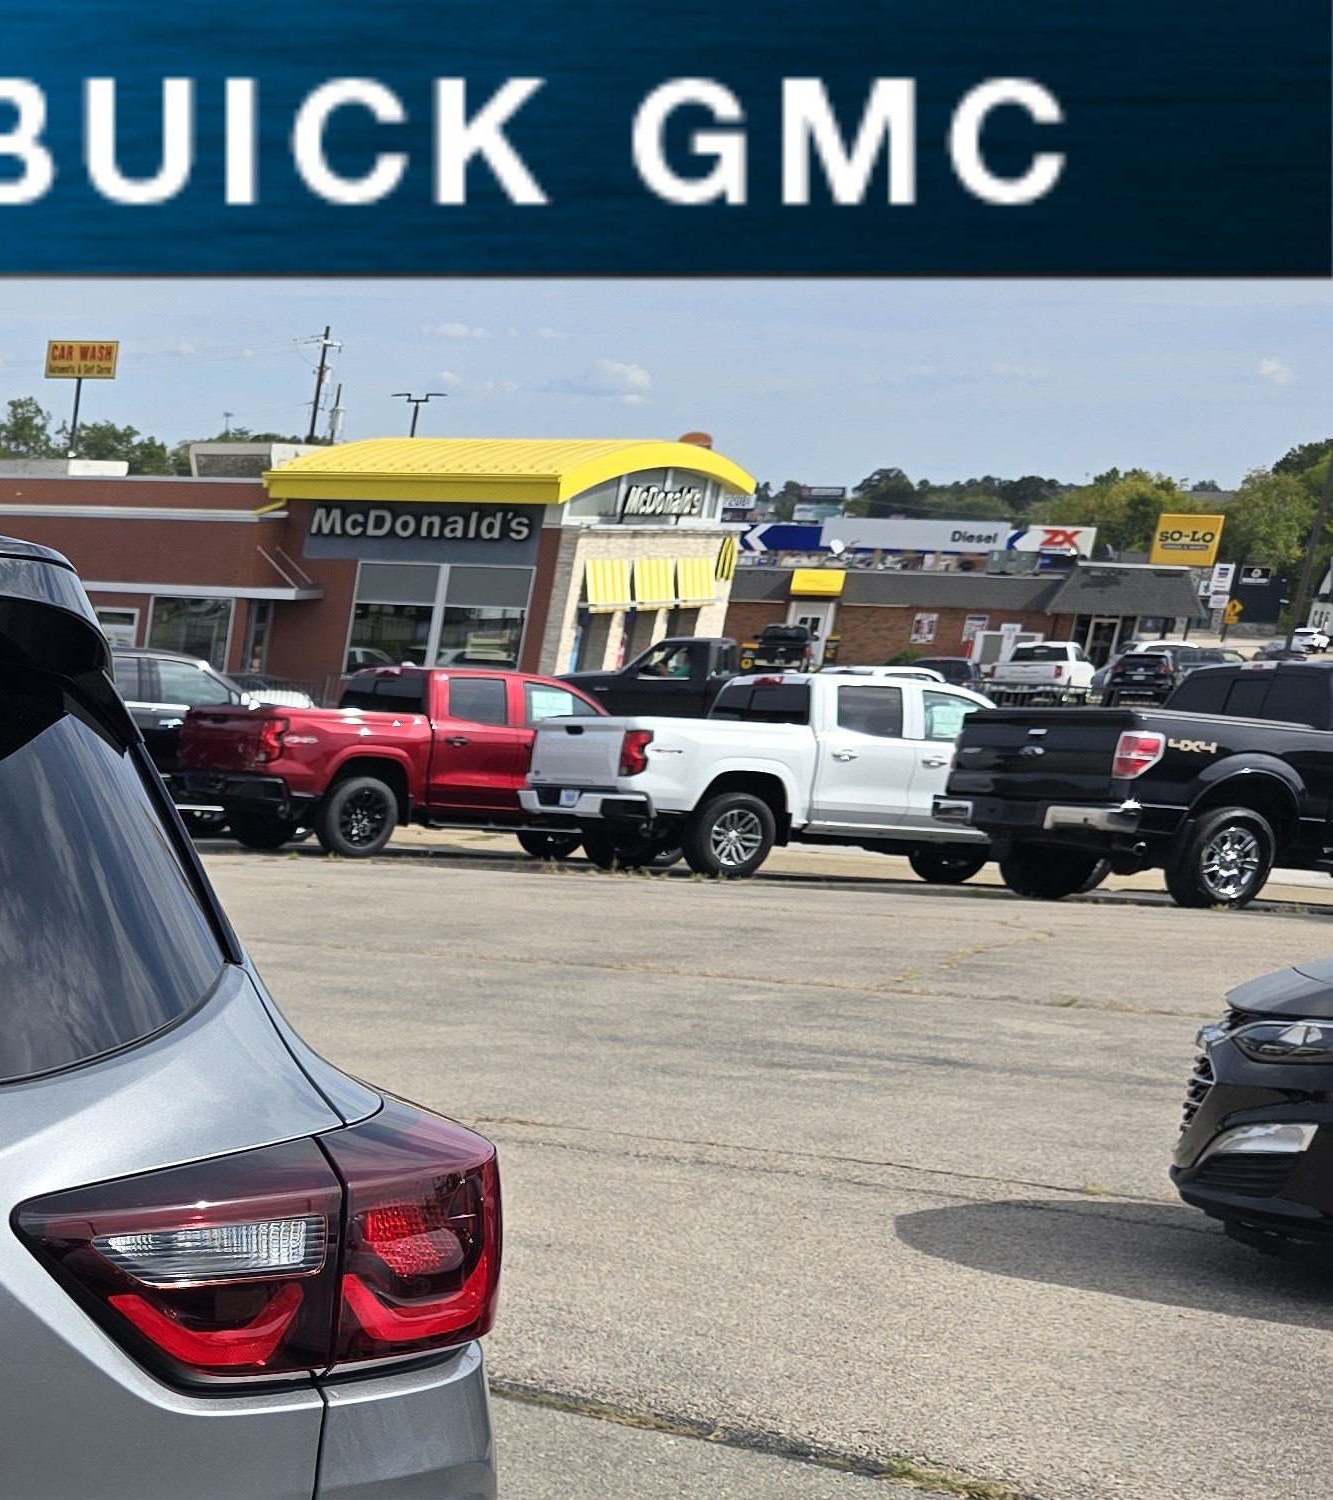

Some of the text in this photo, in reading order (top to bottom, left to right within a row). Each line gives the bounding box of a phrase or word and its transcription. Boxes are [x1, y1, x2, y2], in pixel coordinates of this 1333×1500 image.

[51, 344, 114, 361] CAR WASH
[623, 485, 702, 515] McDonald's
[310, 508, 530, 541] McDonald's
[950, 530, 998, 544] Diesel
[1039, 529, 1082, 547] ZX
[1158, 530, 1215, 543] SO-LO
